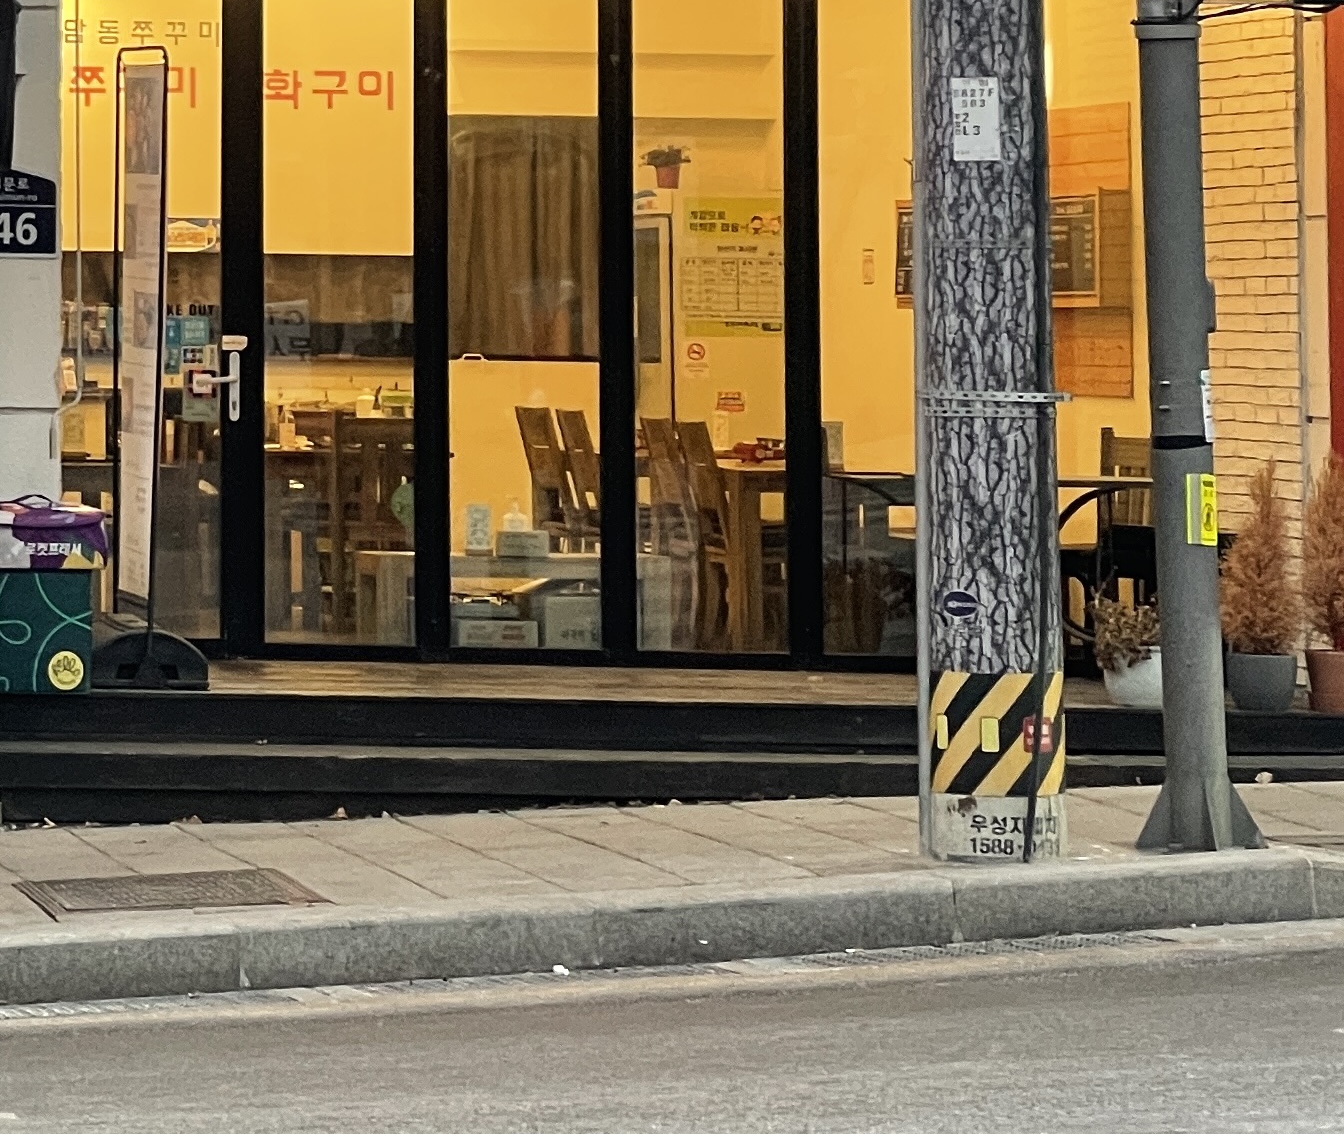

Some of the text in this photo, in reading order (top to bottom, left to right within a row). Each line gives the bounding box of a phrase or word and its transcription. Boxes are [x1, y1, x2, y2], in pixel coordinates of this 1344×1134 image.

[64, 18, 220, 48] 암동쭈꾸미
[69, 66, 394, 111] 쭈미 화구이
[167, 304, 182, 316] KE
[26, 542, 82, 557] 로켓프레시
